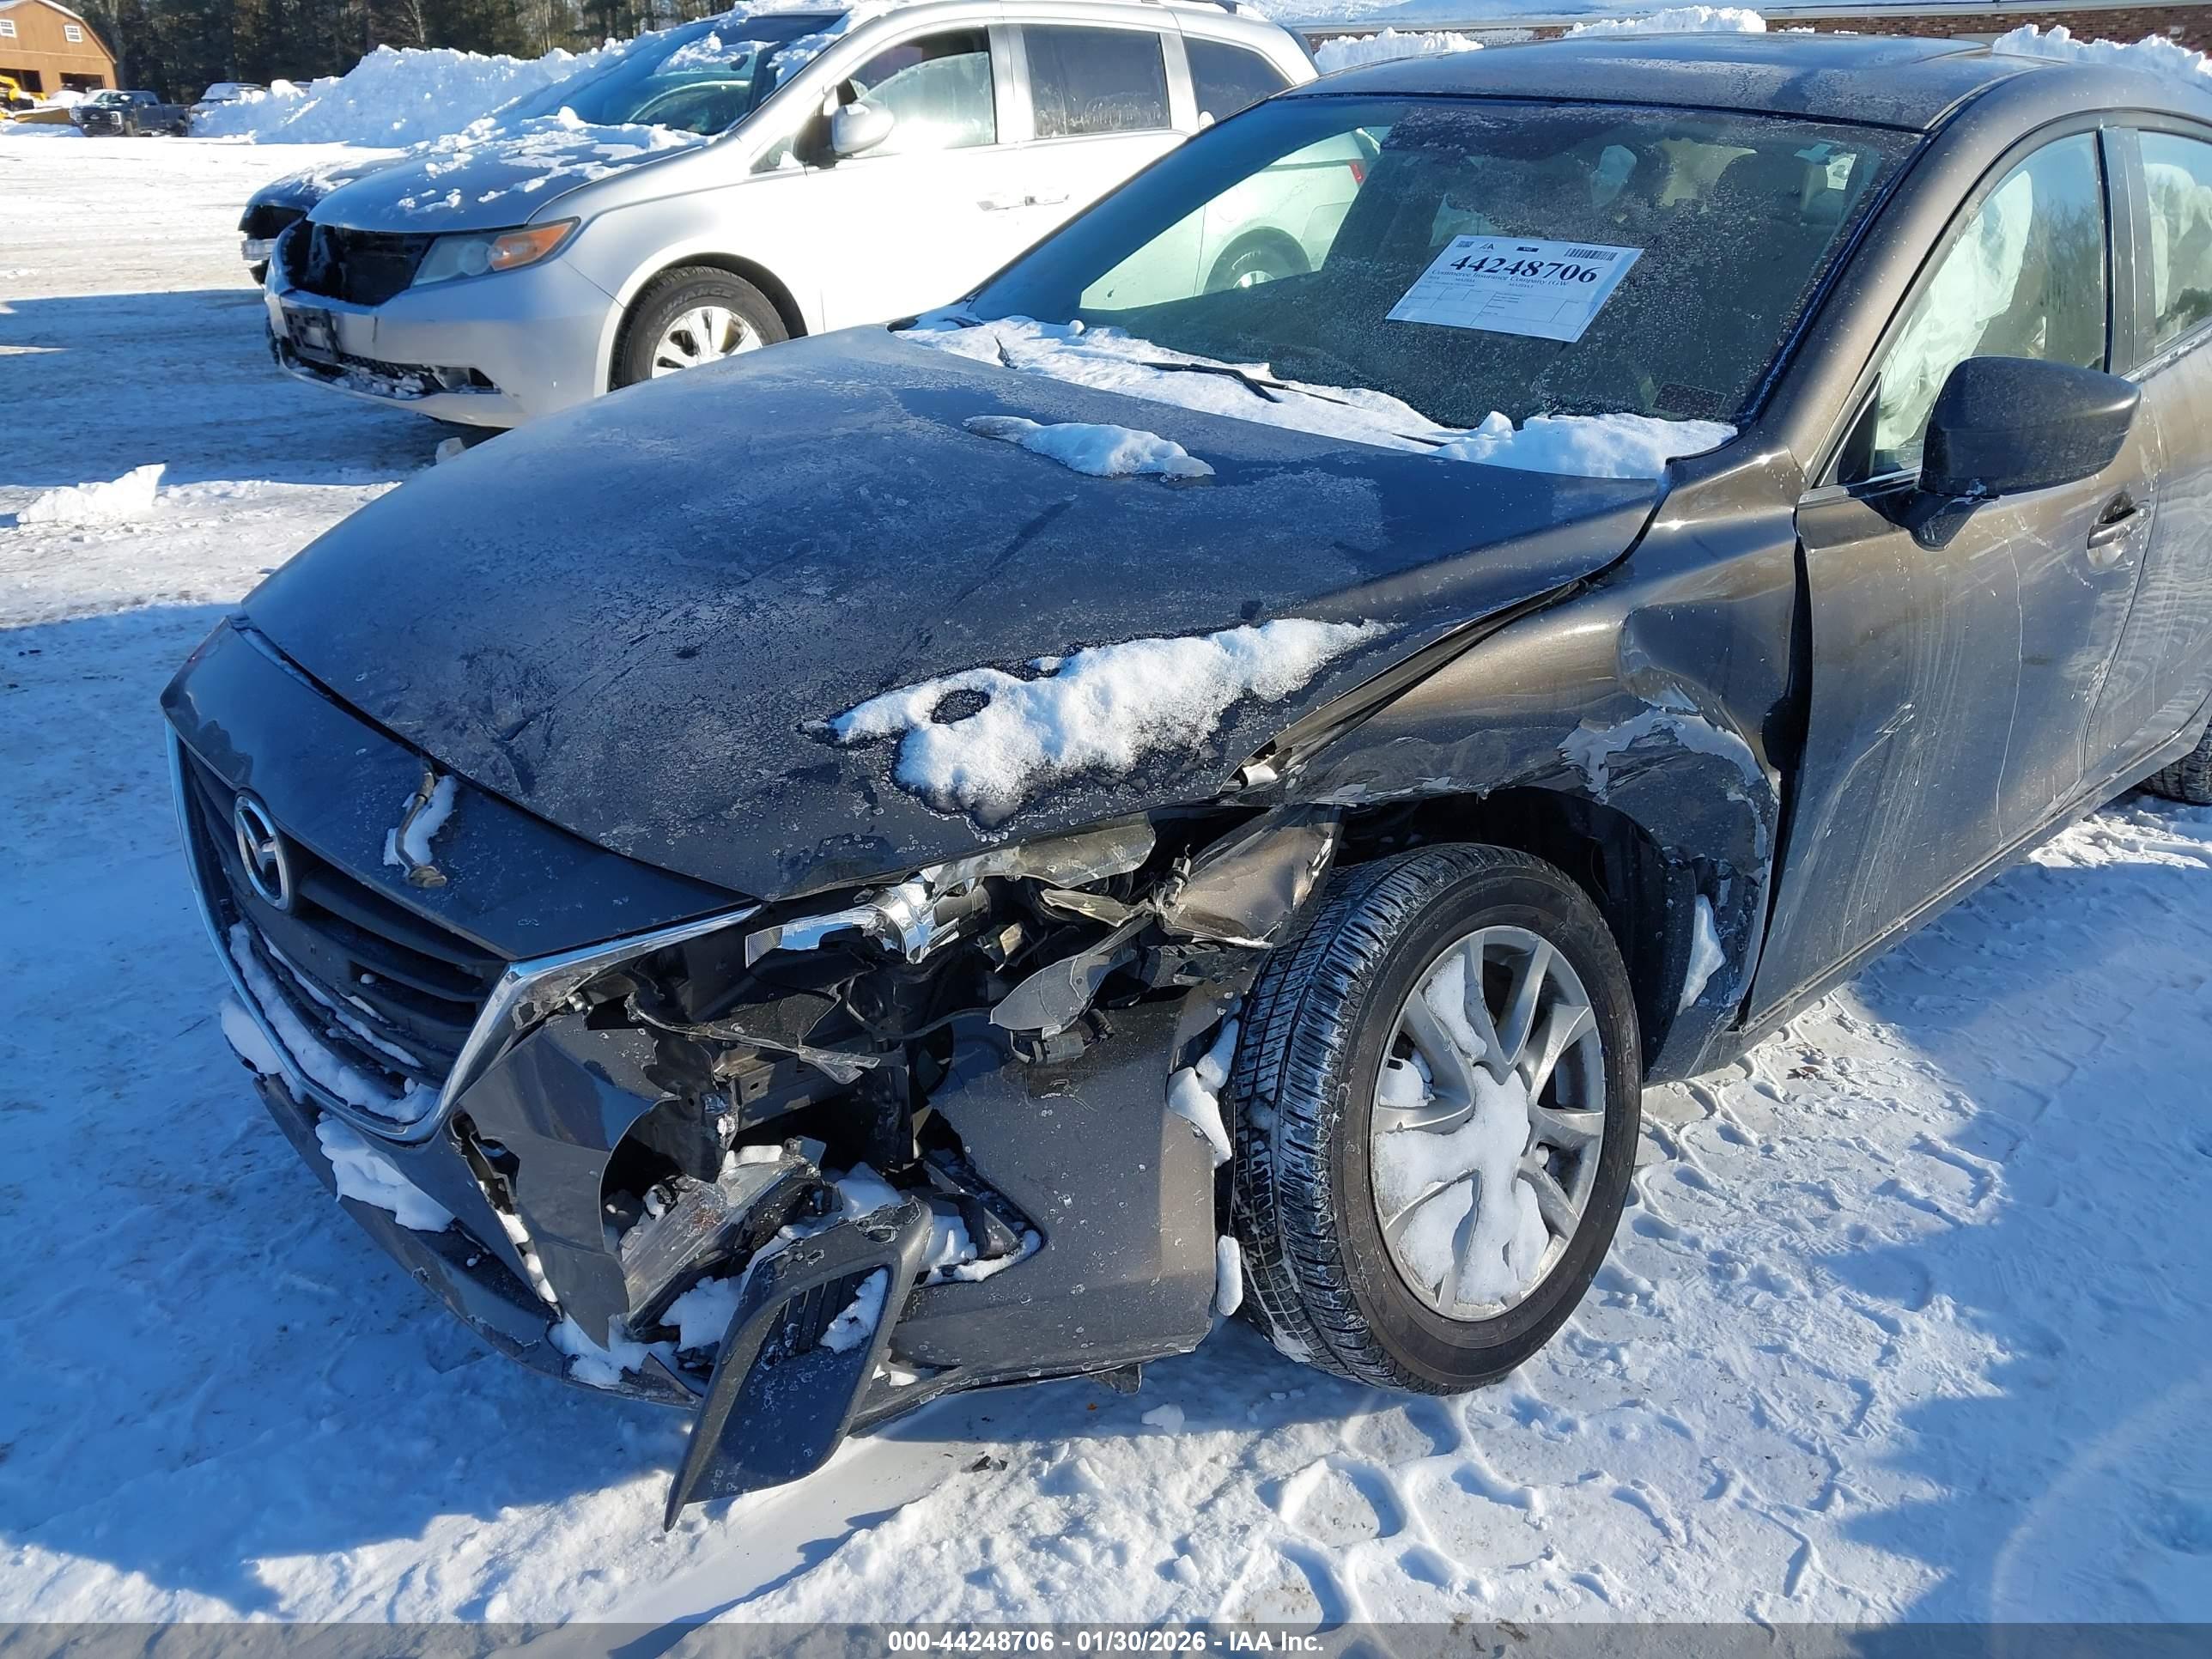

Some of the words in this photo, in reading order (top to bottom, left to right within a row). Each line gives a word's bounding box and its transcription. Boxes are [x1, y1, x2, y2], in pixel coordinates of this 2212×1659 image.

[1449, 255, 1604, 283] 44248706
[1473, 272, 1509, 281] Insurance
[1510, 276, 1547, 285] Company
